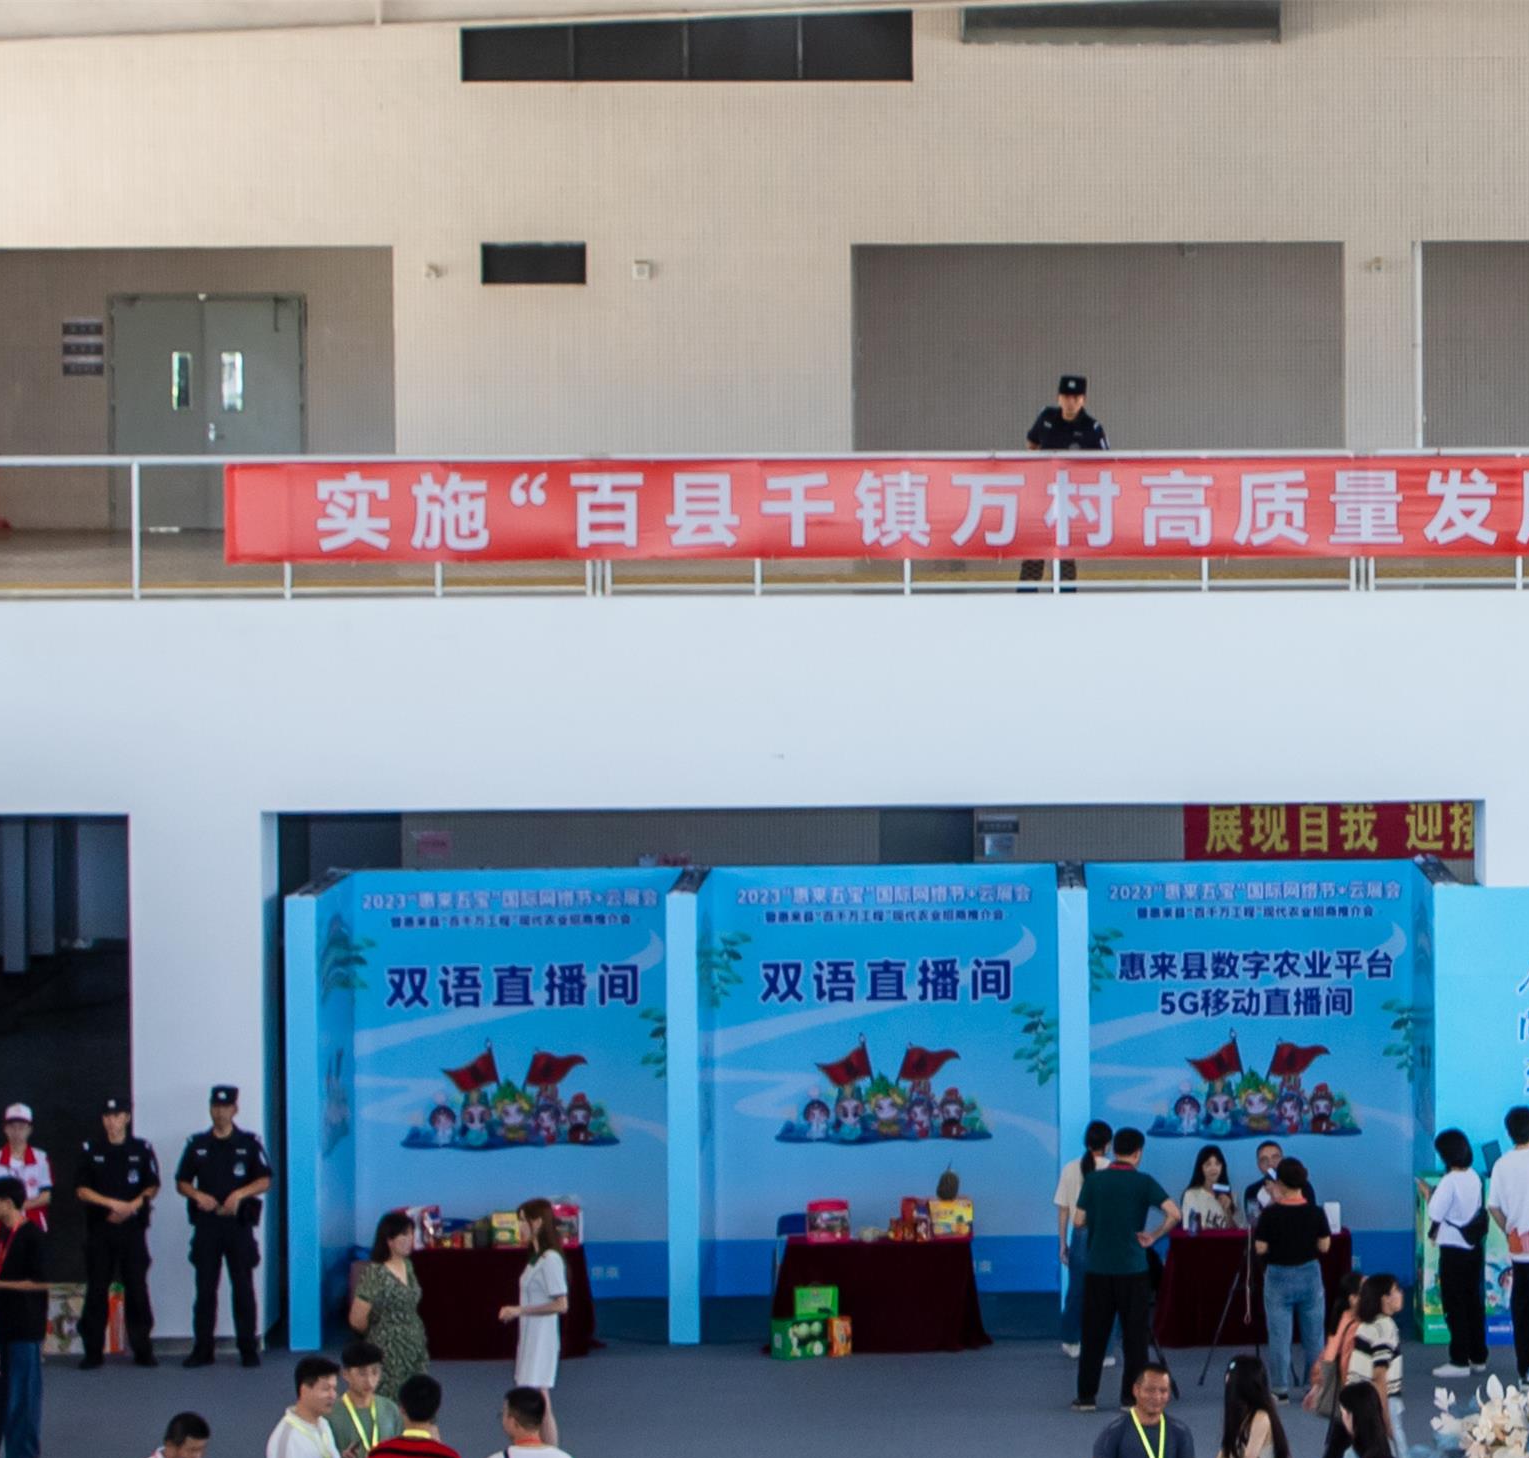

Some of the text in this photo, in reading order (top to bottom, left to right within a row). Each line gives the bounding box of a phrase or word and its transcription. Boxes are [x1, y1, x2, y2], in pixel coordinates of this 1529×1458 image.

[1206, 803, 1378, 853] 展现自我
[386, 963, 641, 1009] 双语直播间
[761, 957, 1013, 1004] 双语直播间
[1119, 950, 1394, 982] 惠来县数字农业平台
[1160, 987, 1354, 1018] 5G移动直播间
